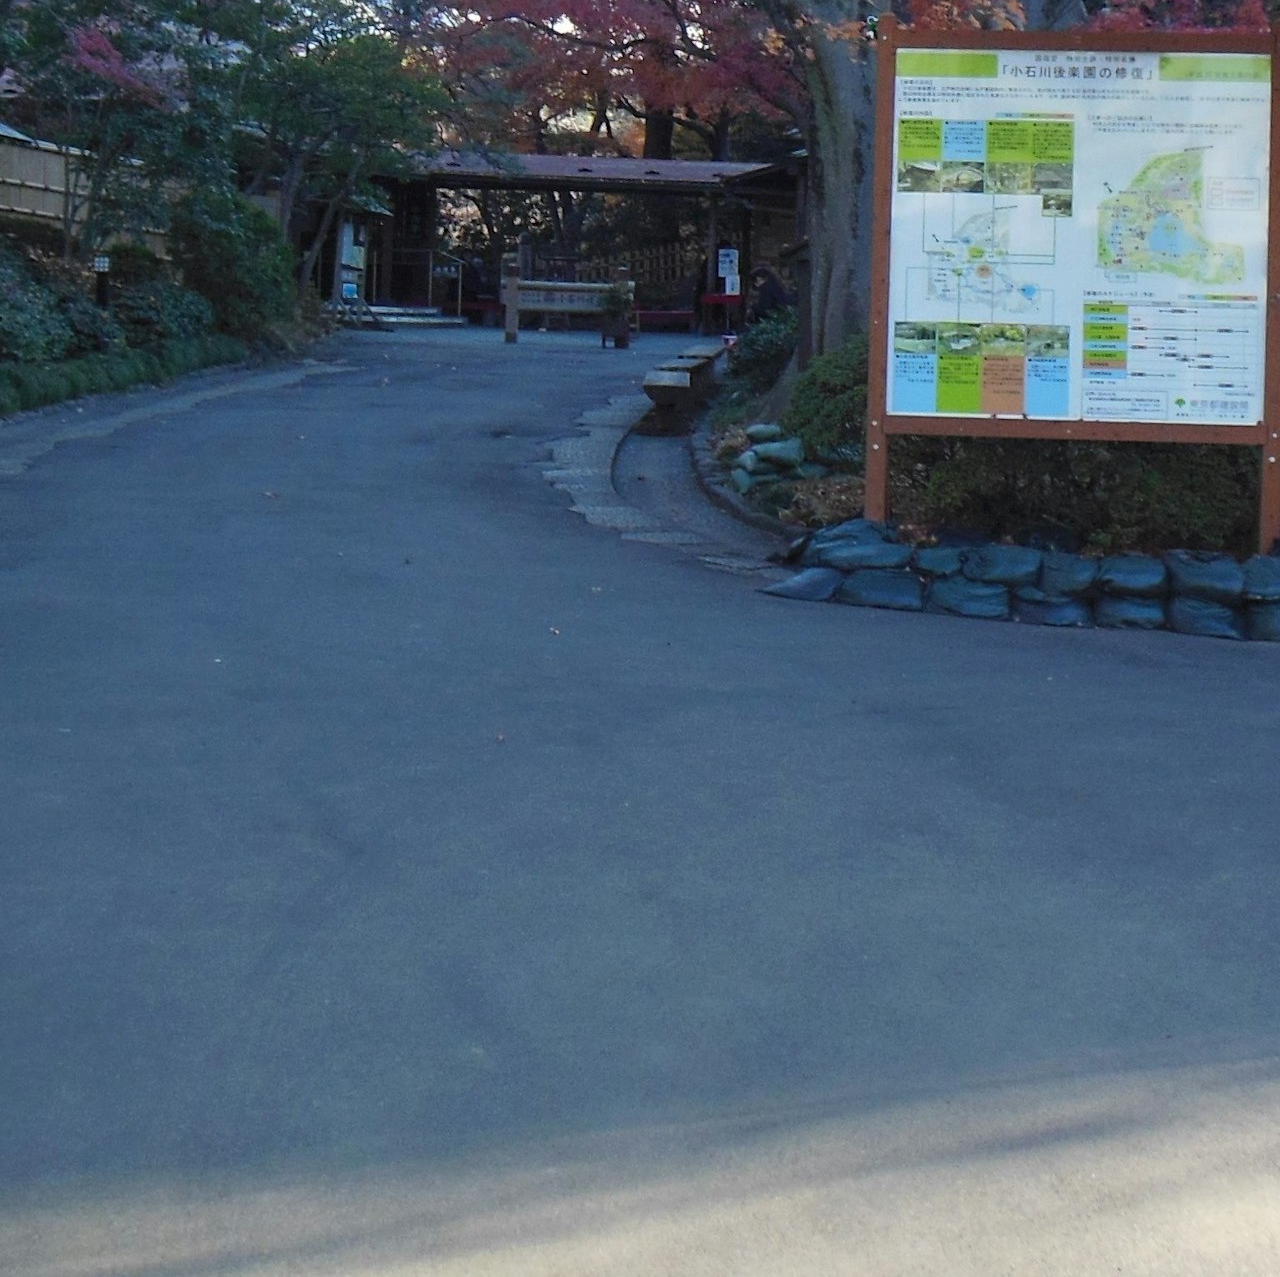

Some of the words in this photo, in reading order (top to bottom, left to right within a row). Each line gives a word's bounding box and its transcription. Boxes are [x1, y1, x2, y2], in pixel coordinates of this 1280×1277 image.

[1001, 64, 1153, 81] 「小石川後楽園の修復」
